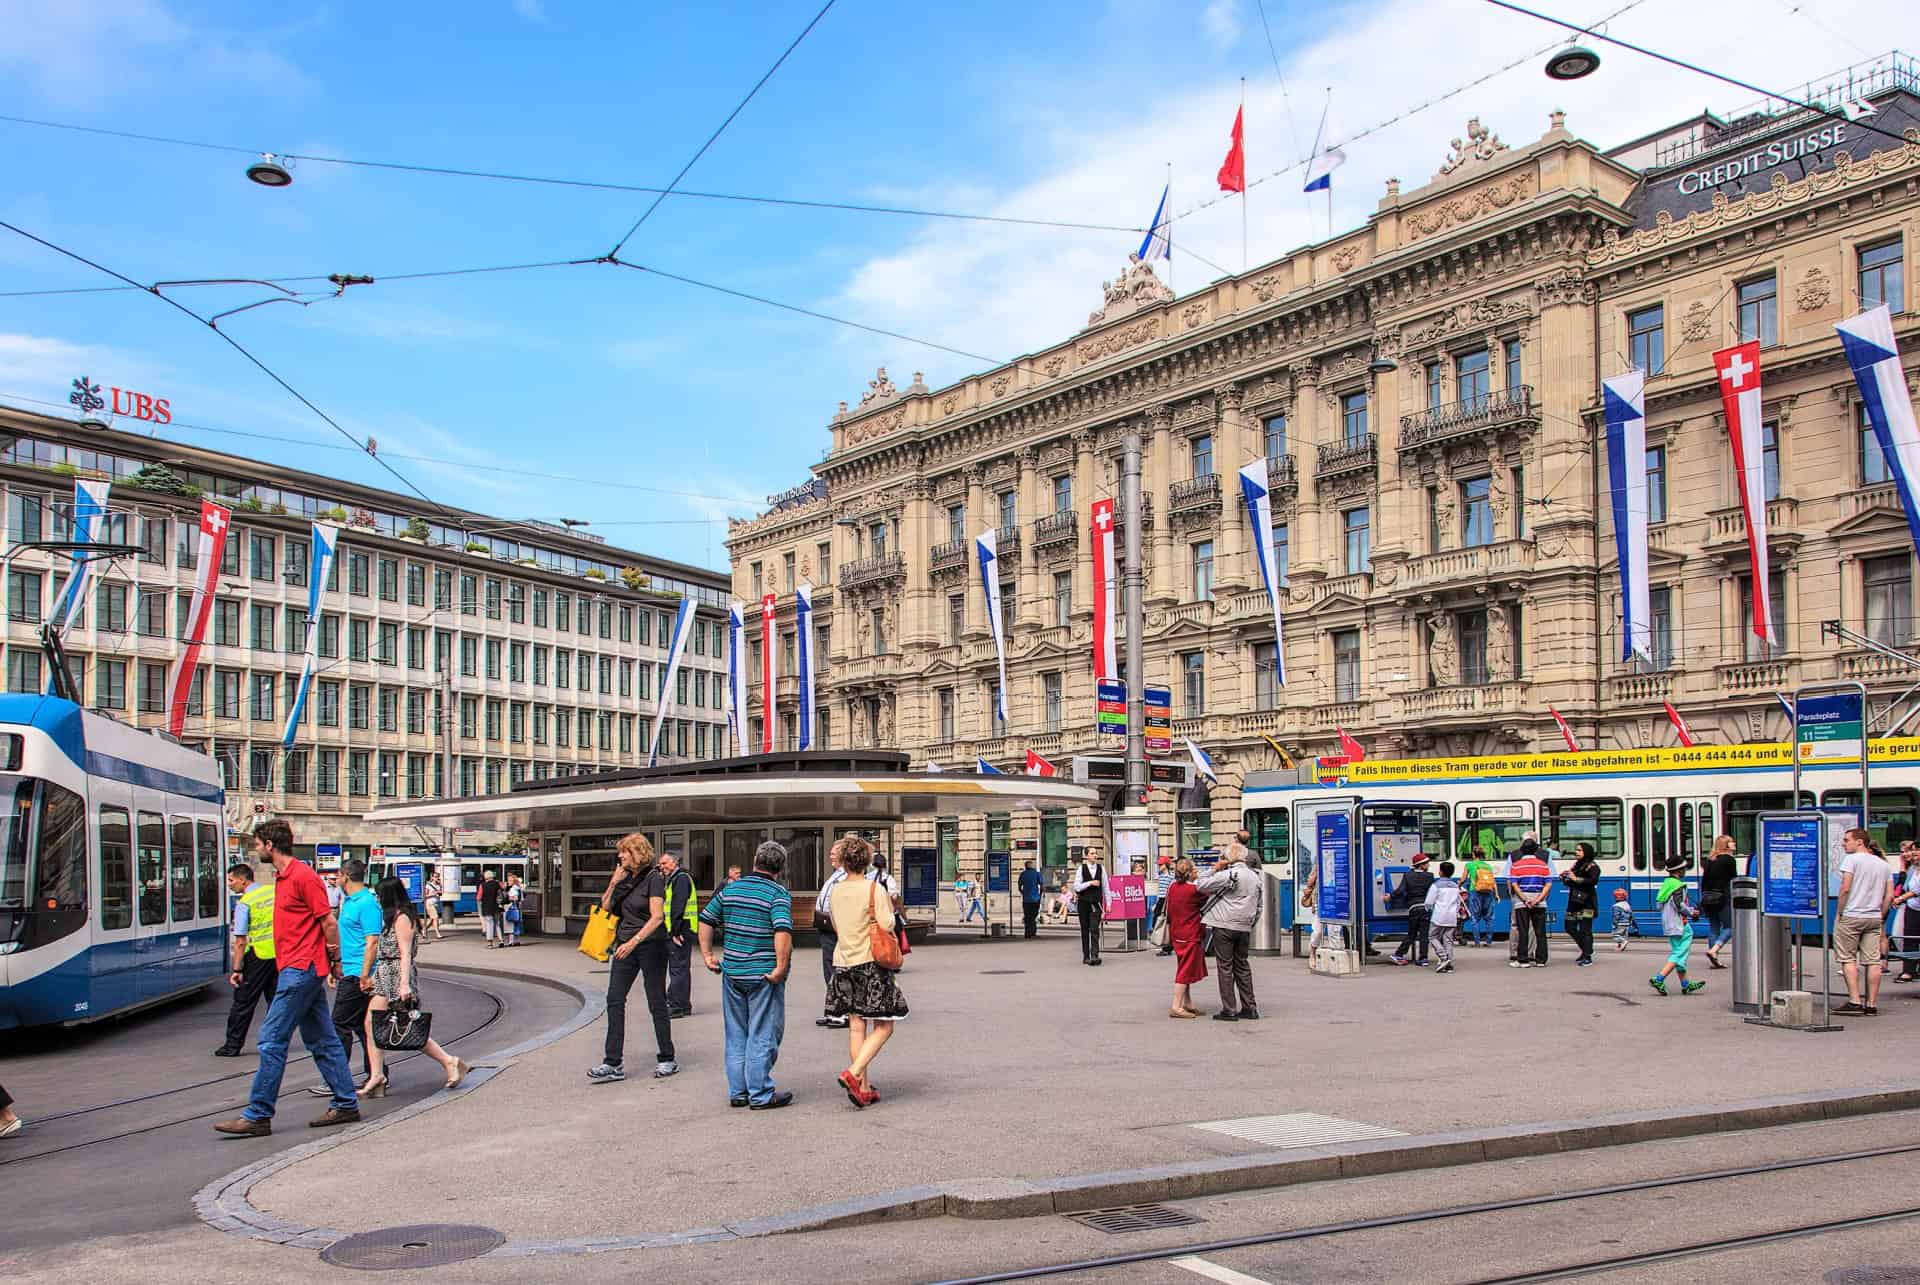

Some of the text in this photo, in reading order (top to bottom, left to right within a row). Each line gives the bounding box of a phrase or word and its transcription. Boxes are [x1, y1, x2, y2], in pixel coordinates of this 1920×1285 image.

[1679, 124, 1847, 194] CREDIT SUISSE
[112, 386, 171, 424] UBS
[1799, 712, 1840, 721] Paradeplatz
[1803, 731, 1813, 741] 11
[1355, 766, 1378, 776] Falls
[1381, 765, 1407, 774] Ihnen
[1410, 764, 1442, 773] dieses
[1445, 762, 1470, 772] Tram
[1473, 760, 1507, 774] gerade
[1511, 761, 1527, 769] vor
[1531, 759, 1548, 769] der
[1552, 758, 1578, 768] Nase
[1581, 756, 1642, 768] abgefahren
[1646, 754, 1660, 764] ist
[1673, 753, 1700, 763] 0444
[1705, 751, 1727, 761] 444
[1730, 750, 1752, 760] 444
[1756, 749, 1778, 758] und
